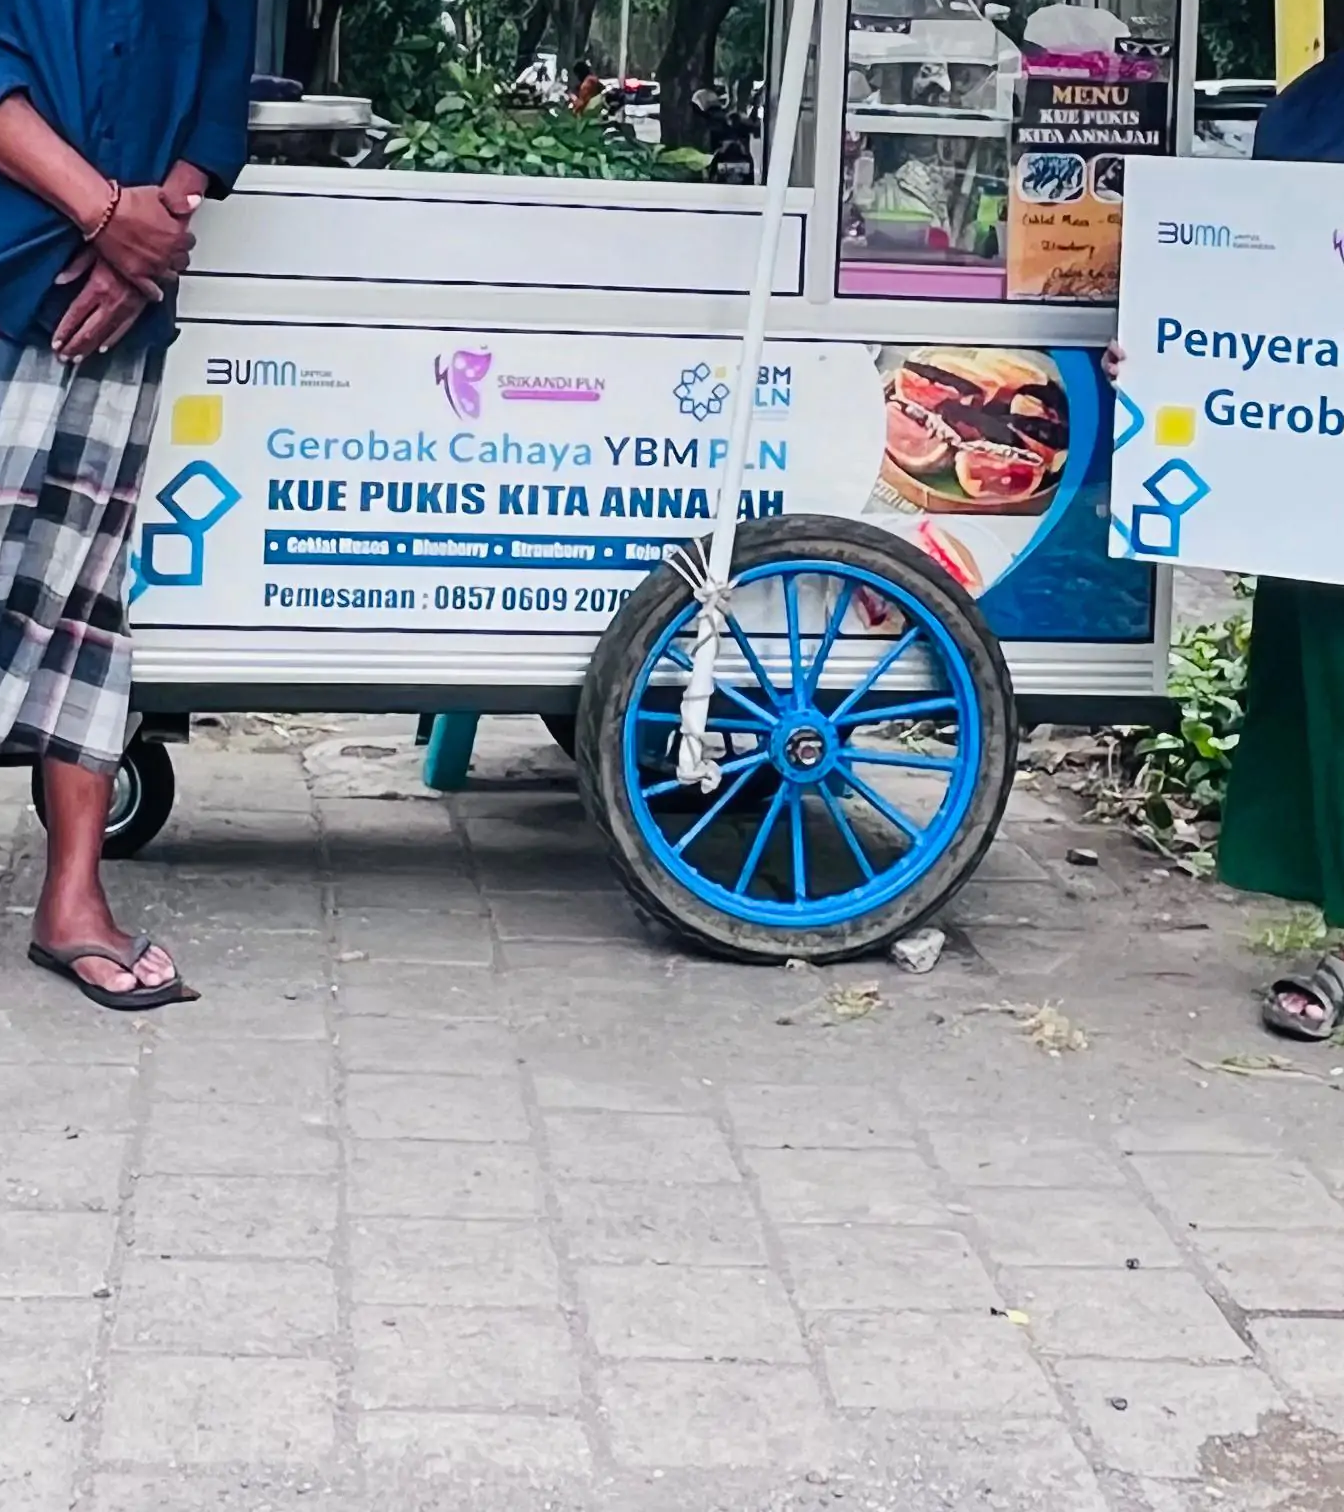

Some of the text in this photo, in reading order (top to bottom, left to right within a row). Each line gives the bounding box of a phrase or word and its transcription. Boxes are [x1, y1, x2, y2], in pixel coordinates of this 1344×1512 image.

[1053, 85, 1129, 105] MENU
[1040, 109, 1139, 125] KUE PUKIS
[1018, 128, 1159, 145] KITA ANNAJAH
[1158, 222, 1230, 247] BUMN
[207, 359, 296, 386] BUMN
[497, 374, 606, 391] SRIKANDI PLN
[737, 365, 792, 385] BM
[754, 387, 791, 406] LN
[267, 428, 787, 472] Gerobak Cahaya YBM PN
[268, 479, 784, 520] KUE PUKIS KITA ANNAAH
[264, 583, 415, 609] Pemesanan
[435, 586, 495, 610] 0857
[502, 587, 567, 611] 0609
